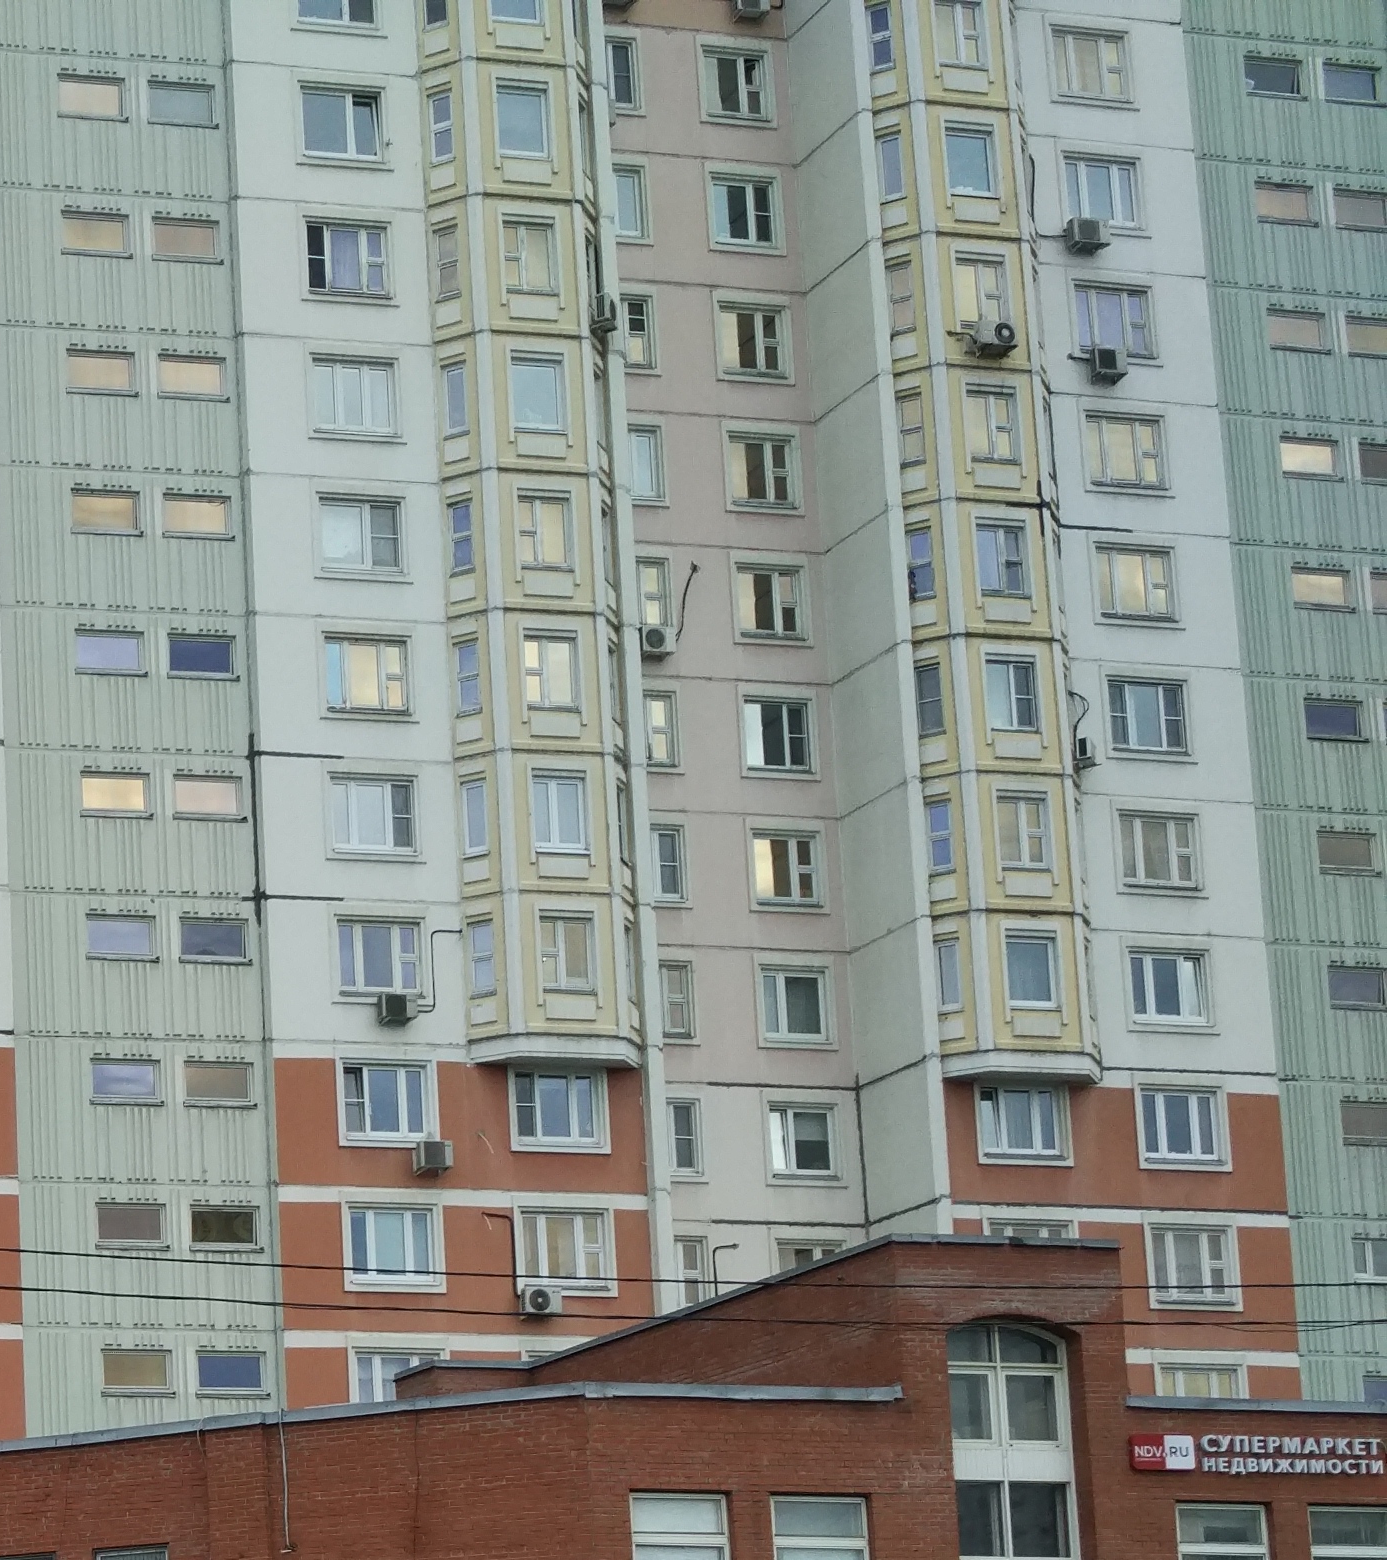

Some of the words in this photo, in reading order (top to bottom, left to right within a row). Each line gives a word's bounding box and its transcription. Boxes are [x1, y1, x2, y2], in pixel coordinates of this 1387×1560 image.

[1134, 1445, 1190, 1458] NDV.RU
[1200, 1434, 1381, 1456] СУПЕРМАРКЕТ
[1201, 1457, 1385, 1475] НЕДВИЖИМОСТИ
